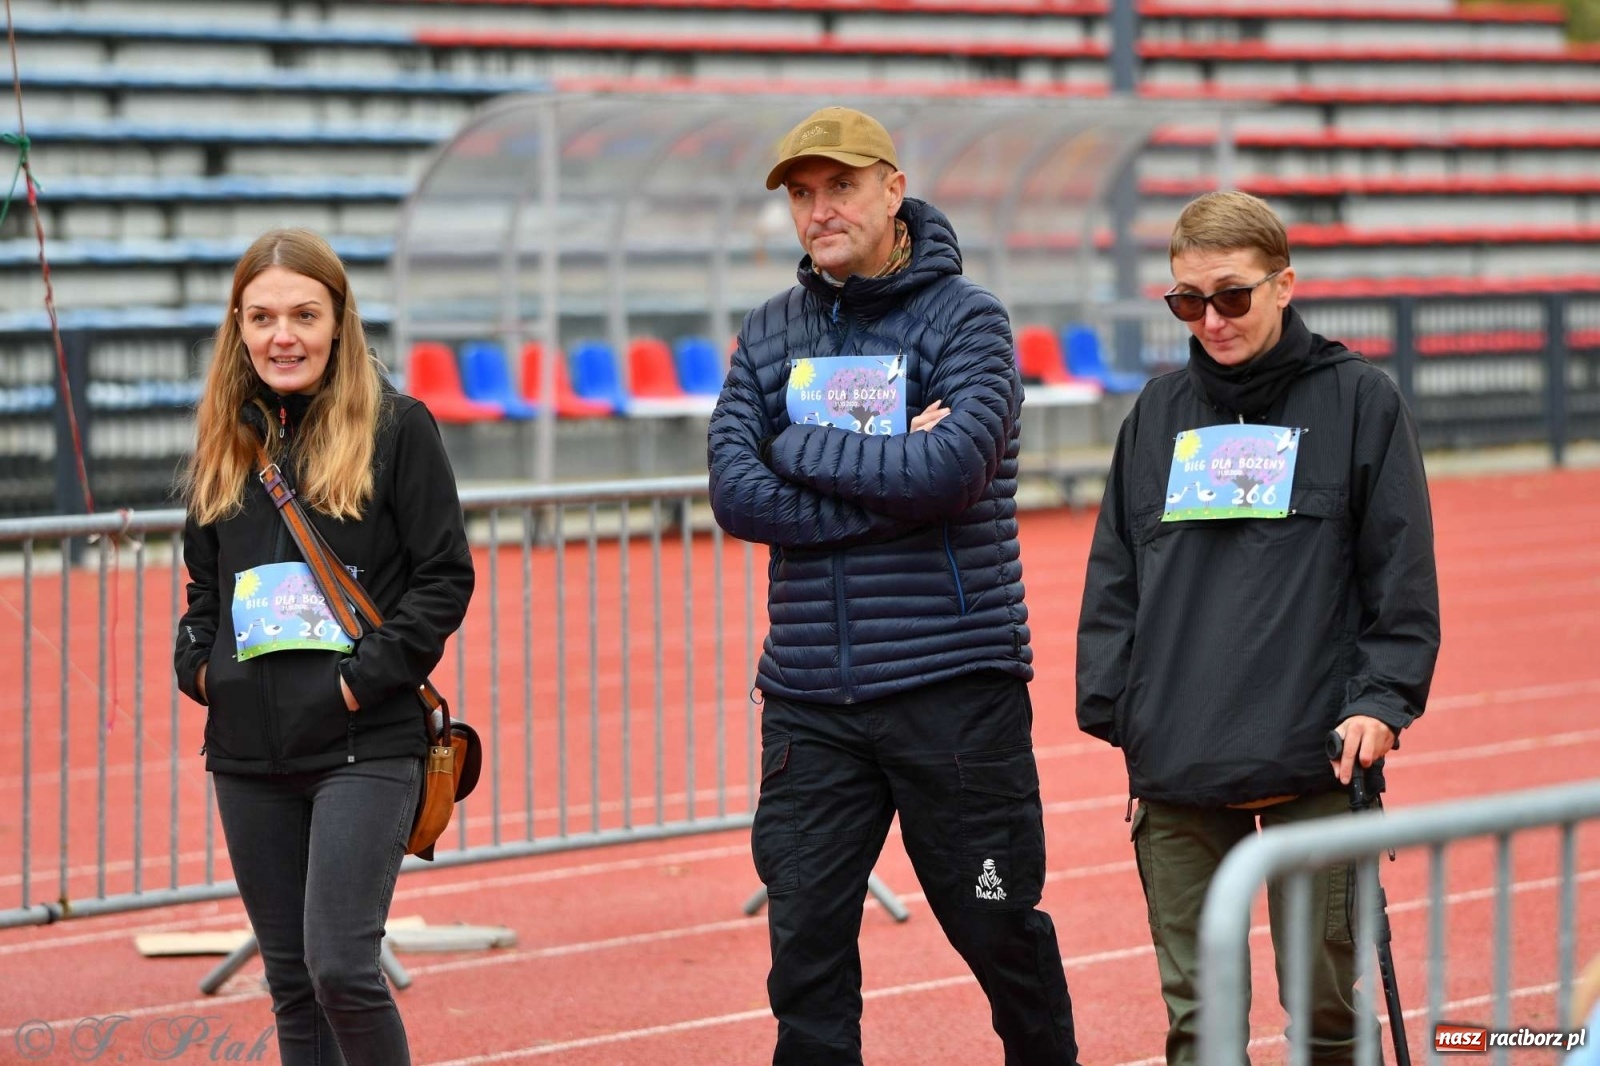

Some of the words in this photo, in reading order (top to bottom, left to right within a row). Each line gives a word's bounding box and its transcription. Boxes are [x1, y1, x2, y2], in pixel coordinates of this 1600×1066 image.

[800, 389, 822, 401] BIEG
[827, 390, 847, 400] DLA
[850, 415, 893, 435] 265
[1184, 461, 1206, 473] BIEG
[1211, 458, 1232, 470] DLA
[1231, 483, 1277, 506] 266
[246, 597, 269, 610] BIEG
[274, 595, 296, 606] DLA
[299, 619, 342, 643] 267
[975, 884, 1006, 901] DAKAR
